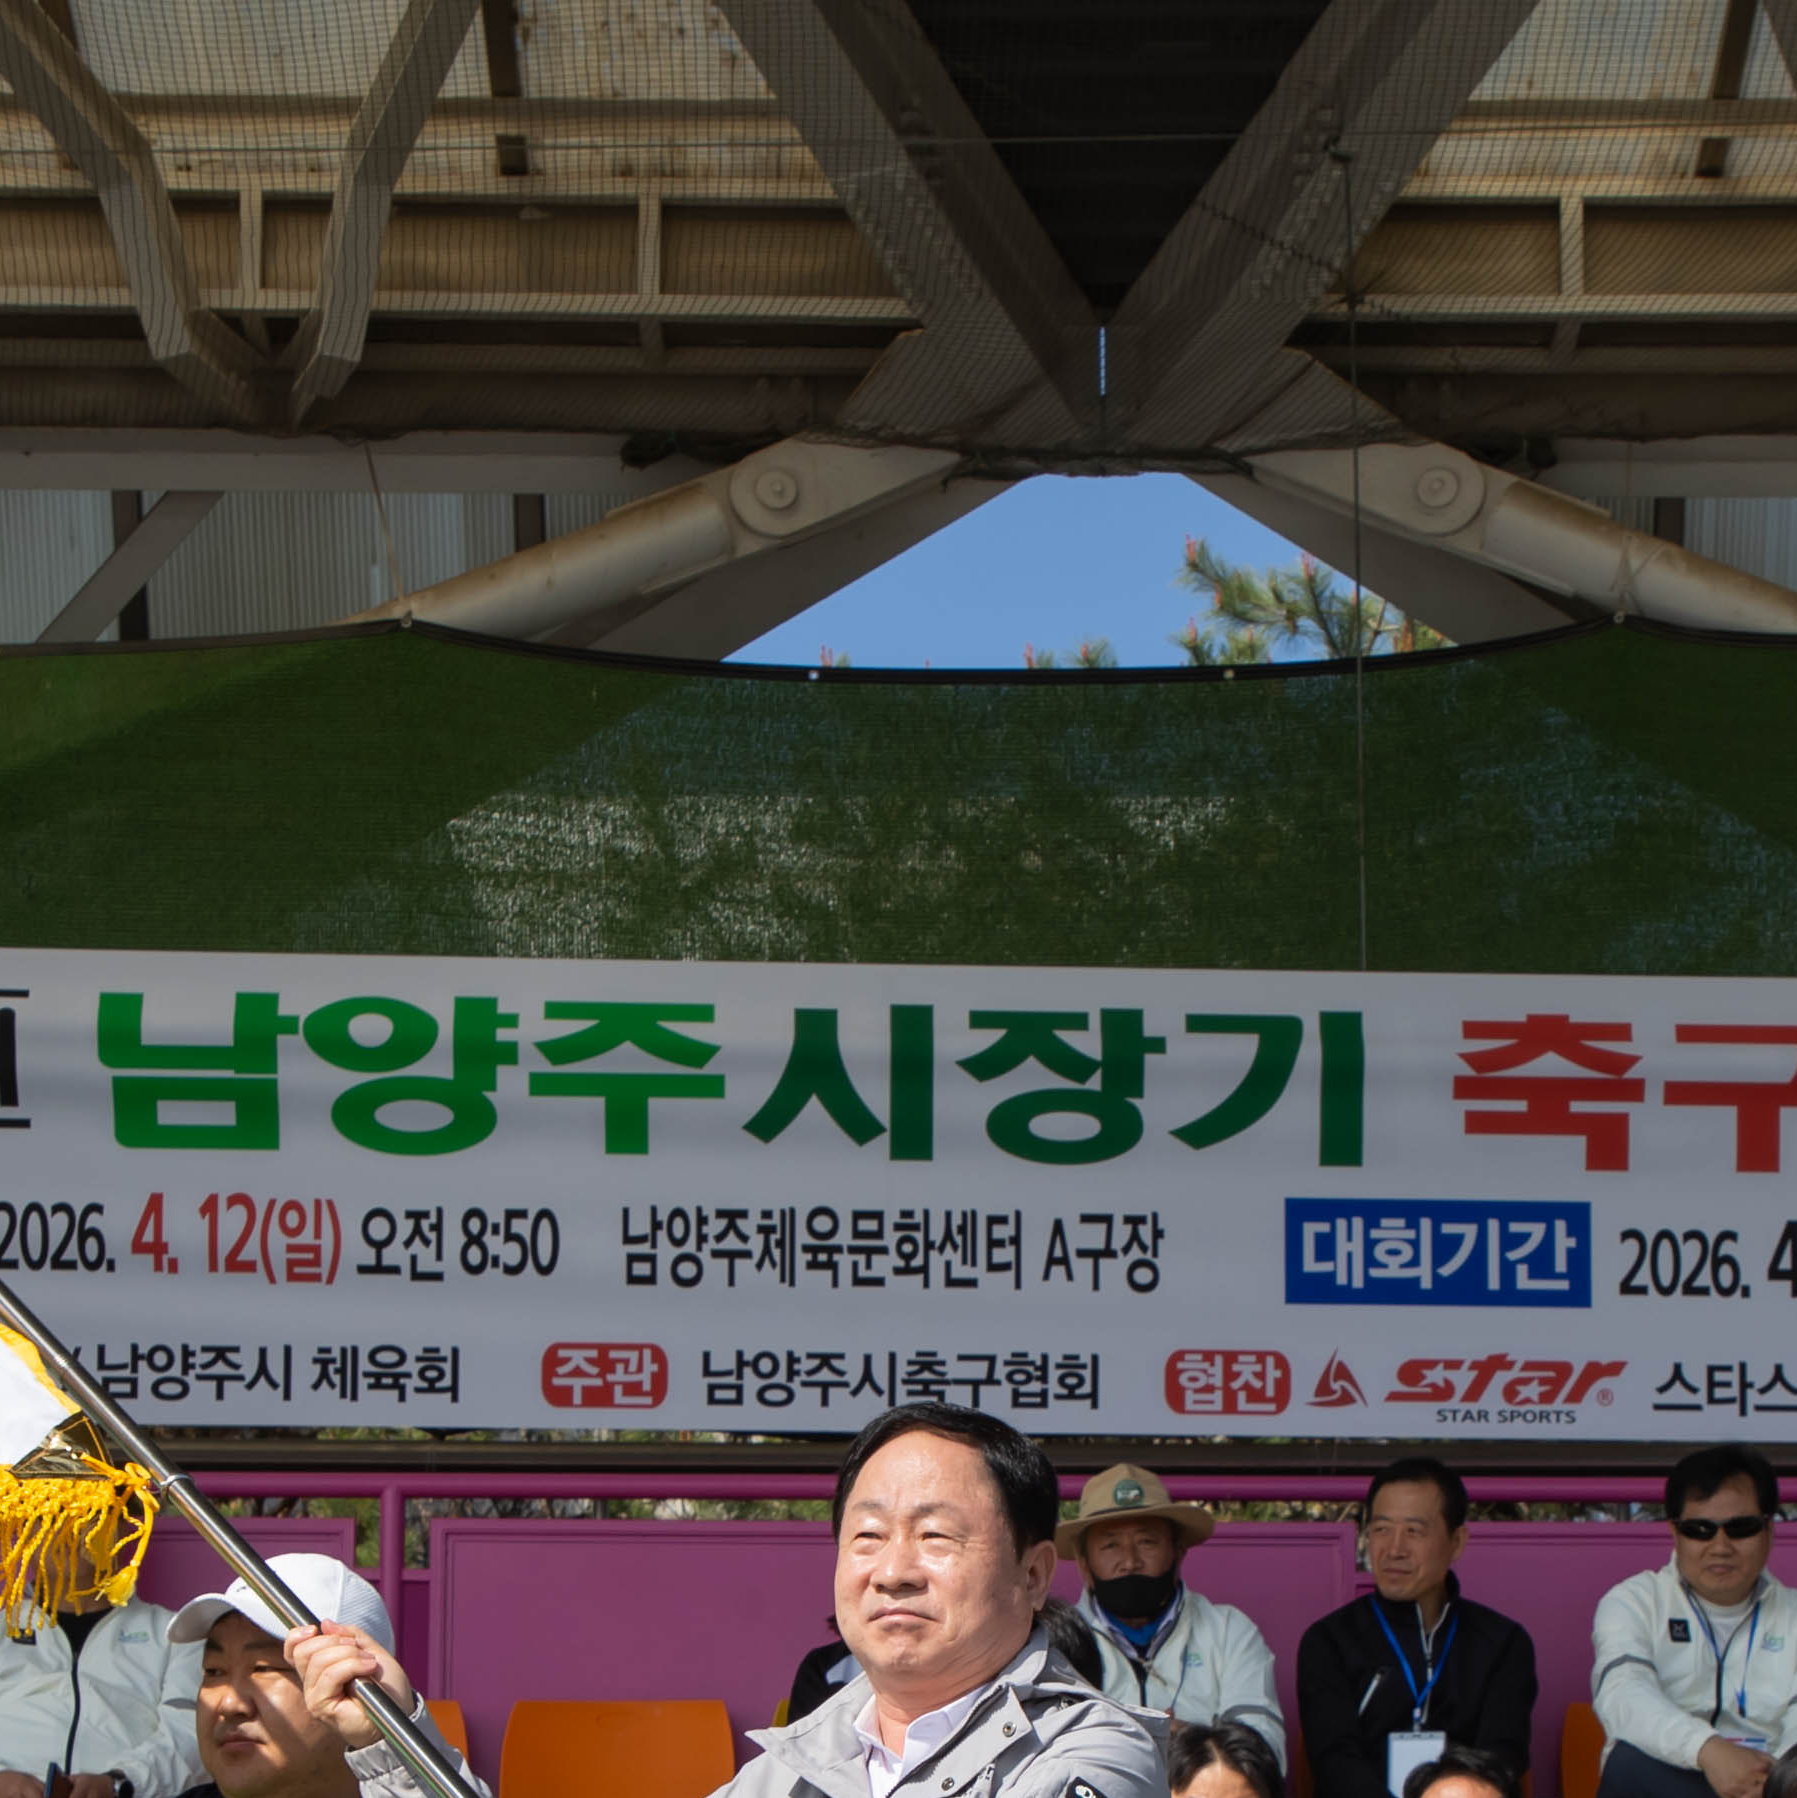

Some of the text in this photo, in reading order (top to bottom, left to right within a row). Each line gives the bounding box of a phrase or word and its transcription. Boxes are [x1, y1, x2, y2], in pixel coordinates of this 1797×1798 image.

[97, 991, 1364, 1166] 남양주시장기
[132, 1193, 179, 1274] 4.
[200, 1193, 342, 1285] 12(일)
[356, 1206, 445, 1282] 오전
[460, 1207, 560, 1277] 8:50
[621, 1205, 1022, 1290] 남양주체육문화센터
[1042, 1211, 1165, 1294] A구장
[1302, 1216, 1577, 1291] 대회기간
[1618, 1228, 1751, 1299] 2026.
[95, 1343, 461, 1403] 남양주시 체육회
[552, 1348, 659, 1406] 주관
[702, 1349, 1100, 1409] 남양주시축구협회
[1175, 1354, 1282, 1413] 협찬
[1436, 1408, 1577, 1424] STAR SPORTS
